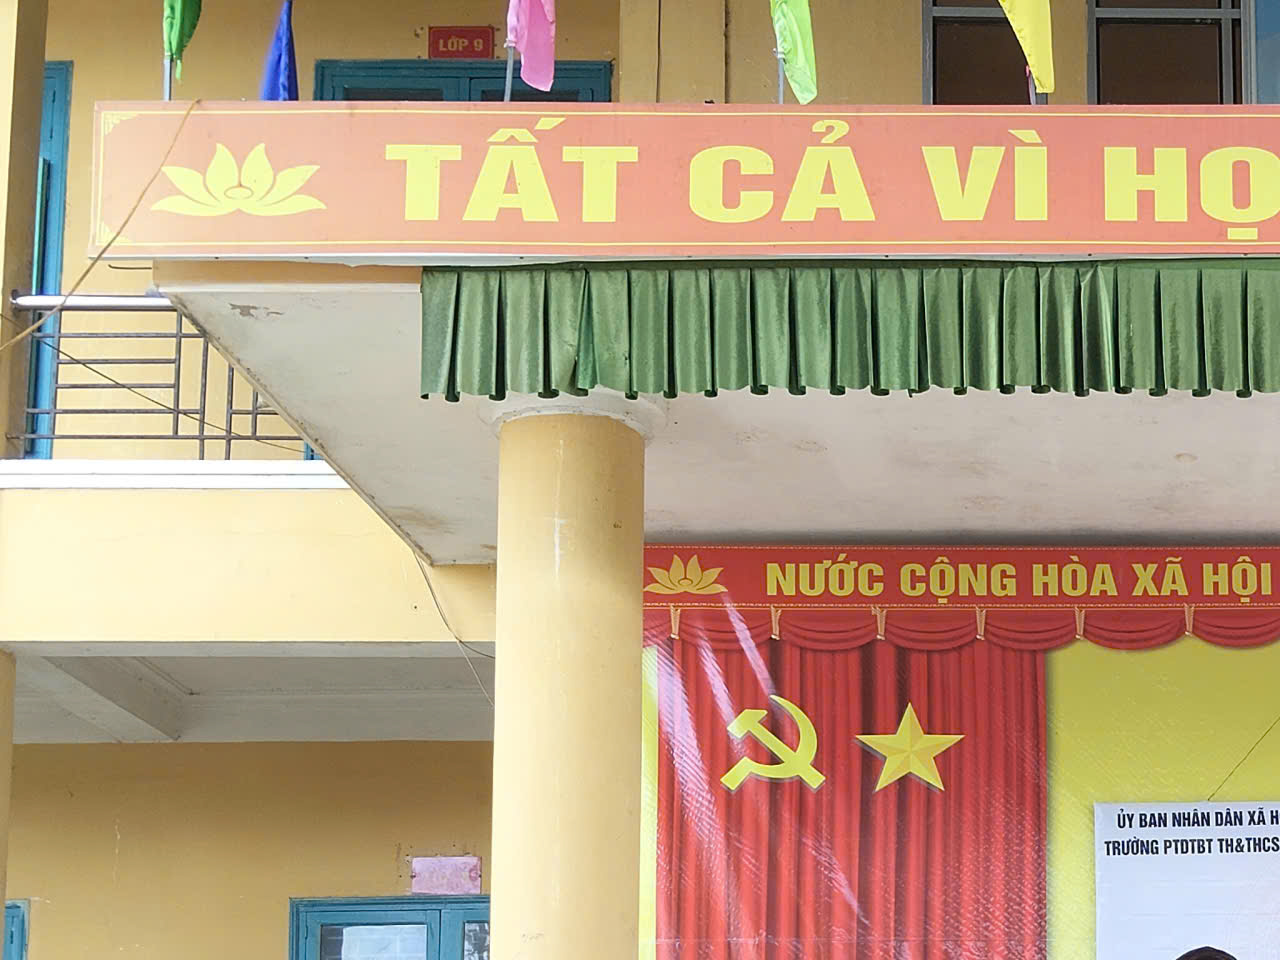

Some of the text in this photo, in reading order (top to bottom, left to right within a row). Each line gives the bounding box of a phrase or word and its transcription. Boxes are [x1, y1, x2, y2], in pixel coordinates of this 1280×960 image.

[474, 38, 483, 51] 9
[386, 117, 638, 222] TẤT
[689, 120, 876, 223] CẢ
[922, 129, 1047, 221] VÌ
[766, 553, 884, 596] NƯỚC
[900, 556, 1017, 603] CỘNG
[1032, 555, 1118, 596] HÒA
[1131, 556, 1189, 596] XÃ
[1203, 555, 1271, 603] HỘI
[1117, 808, 1135, 828] ỦY
[1139, 812, 1167, 828] BAN
[1172, 808, 1211, 827] NHÂN
[1215, 808, 1243, 827] DÂN
[1247, 808, 1266, 826] XÃ
[1104, 836, 1159, 856] TRƯỜNG
[1164, 838, 1213, 855] PTDTBT
[1217, 836, 1280, 853] TH&THCS
